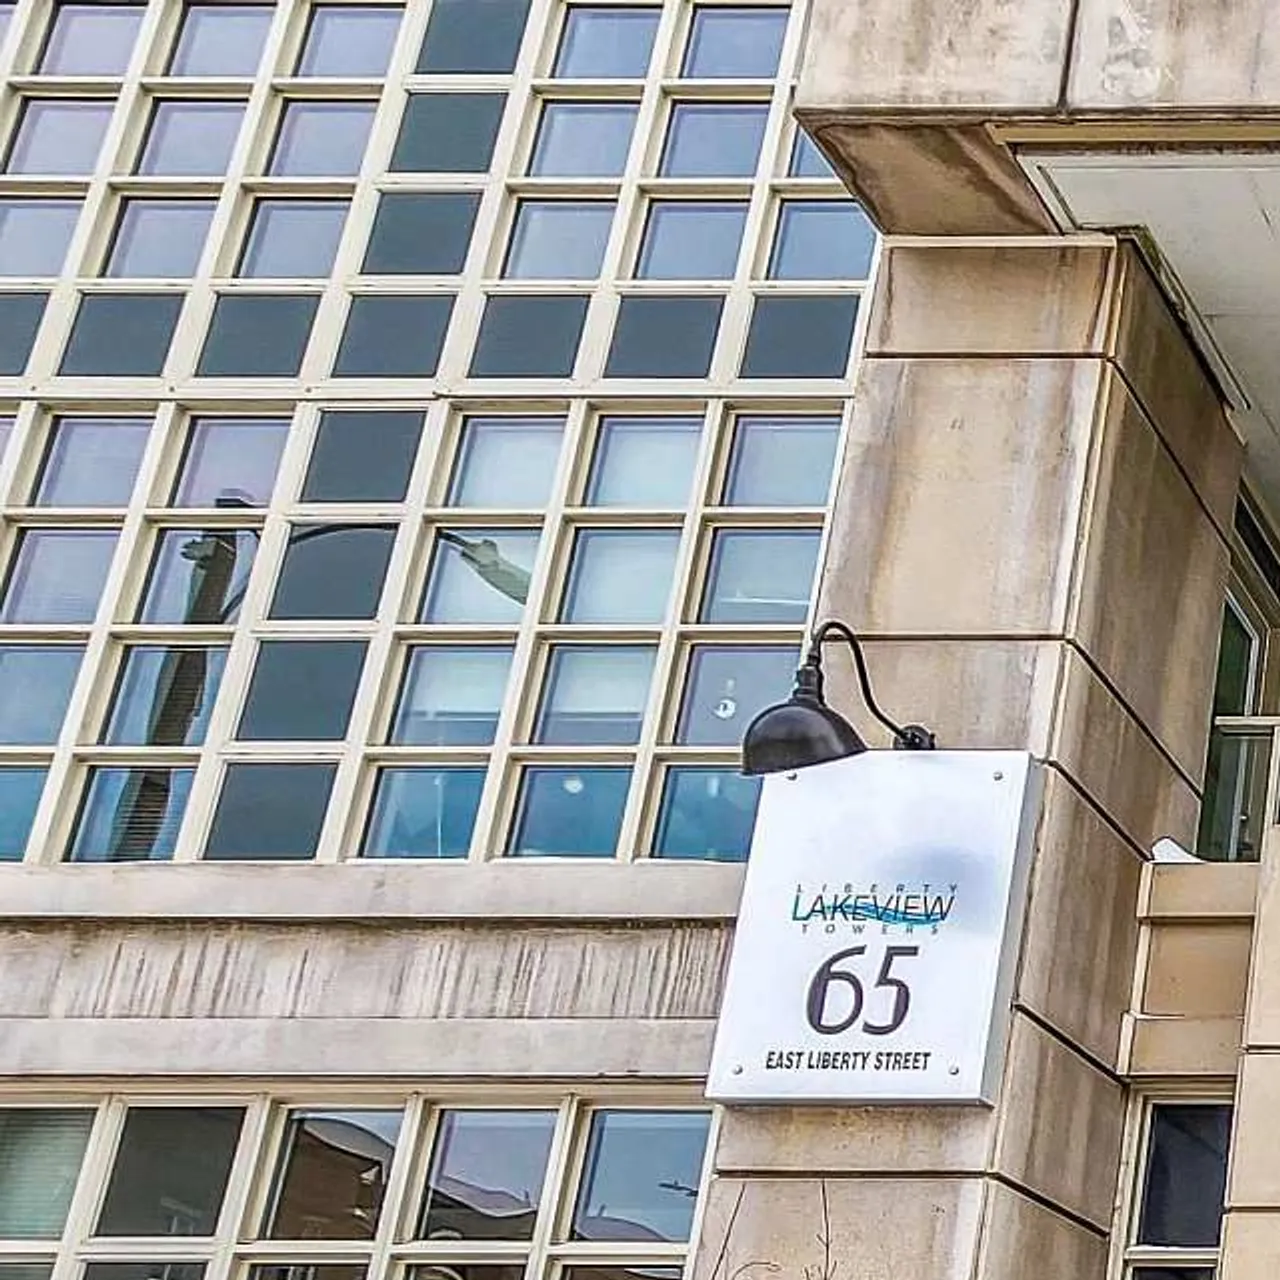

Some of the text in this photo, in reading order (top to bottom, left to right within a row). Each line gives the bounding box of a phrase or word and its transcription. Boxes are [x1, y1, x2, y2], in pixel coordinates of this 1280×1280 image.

[797, 883, 957, 893] LIBERTY
[792, 894, 955, 922] LAKEVIEW
[802, 924, 938, 935] TOWERS
[806, 944, 920, 1035] 65
[765, 1051, 932, 1070] EAST LIBERTY STREET
